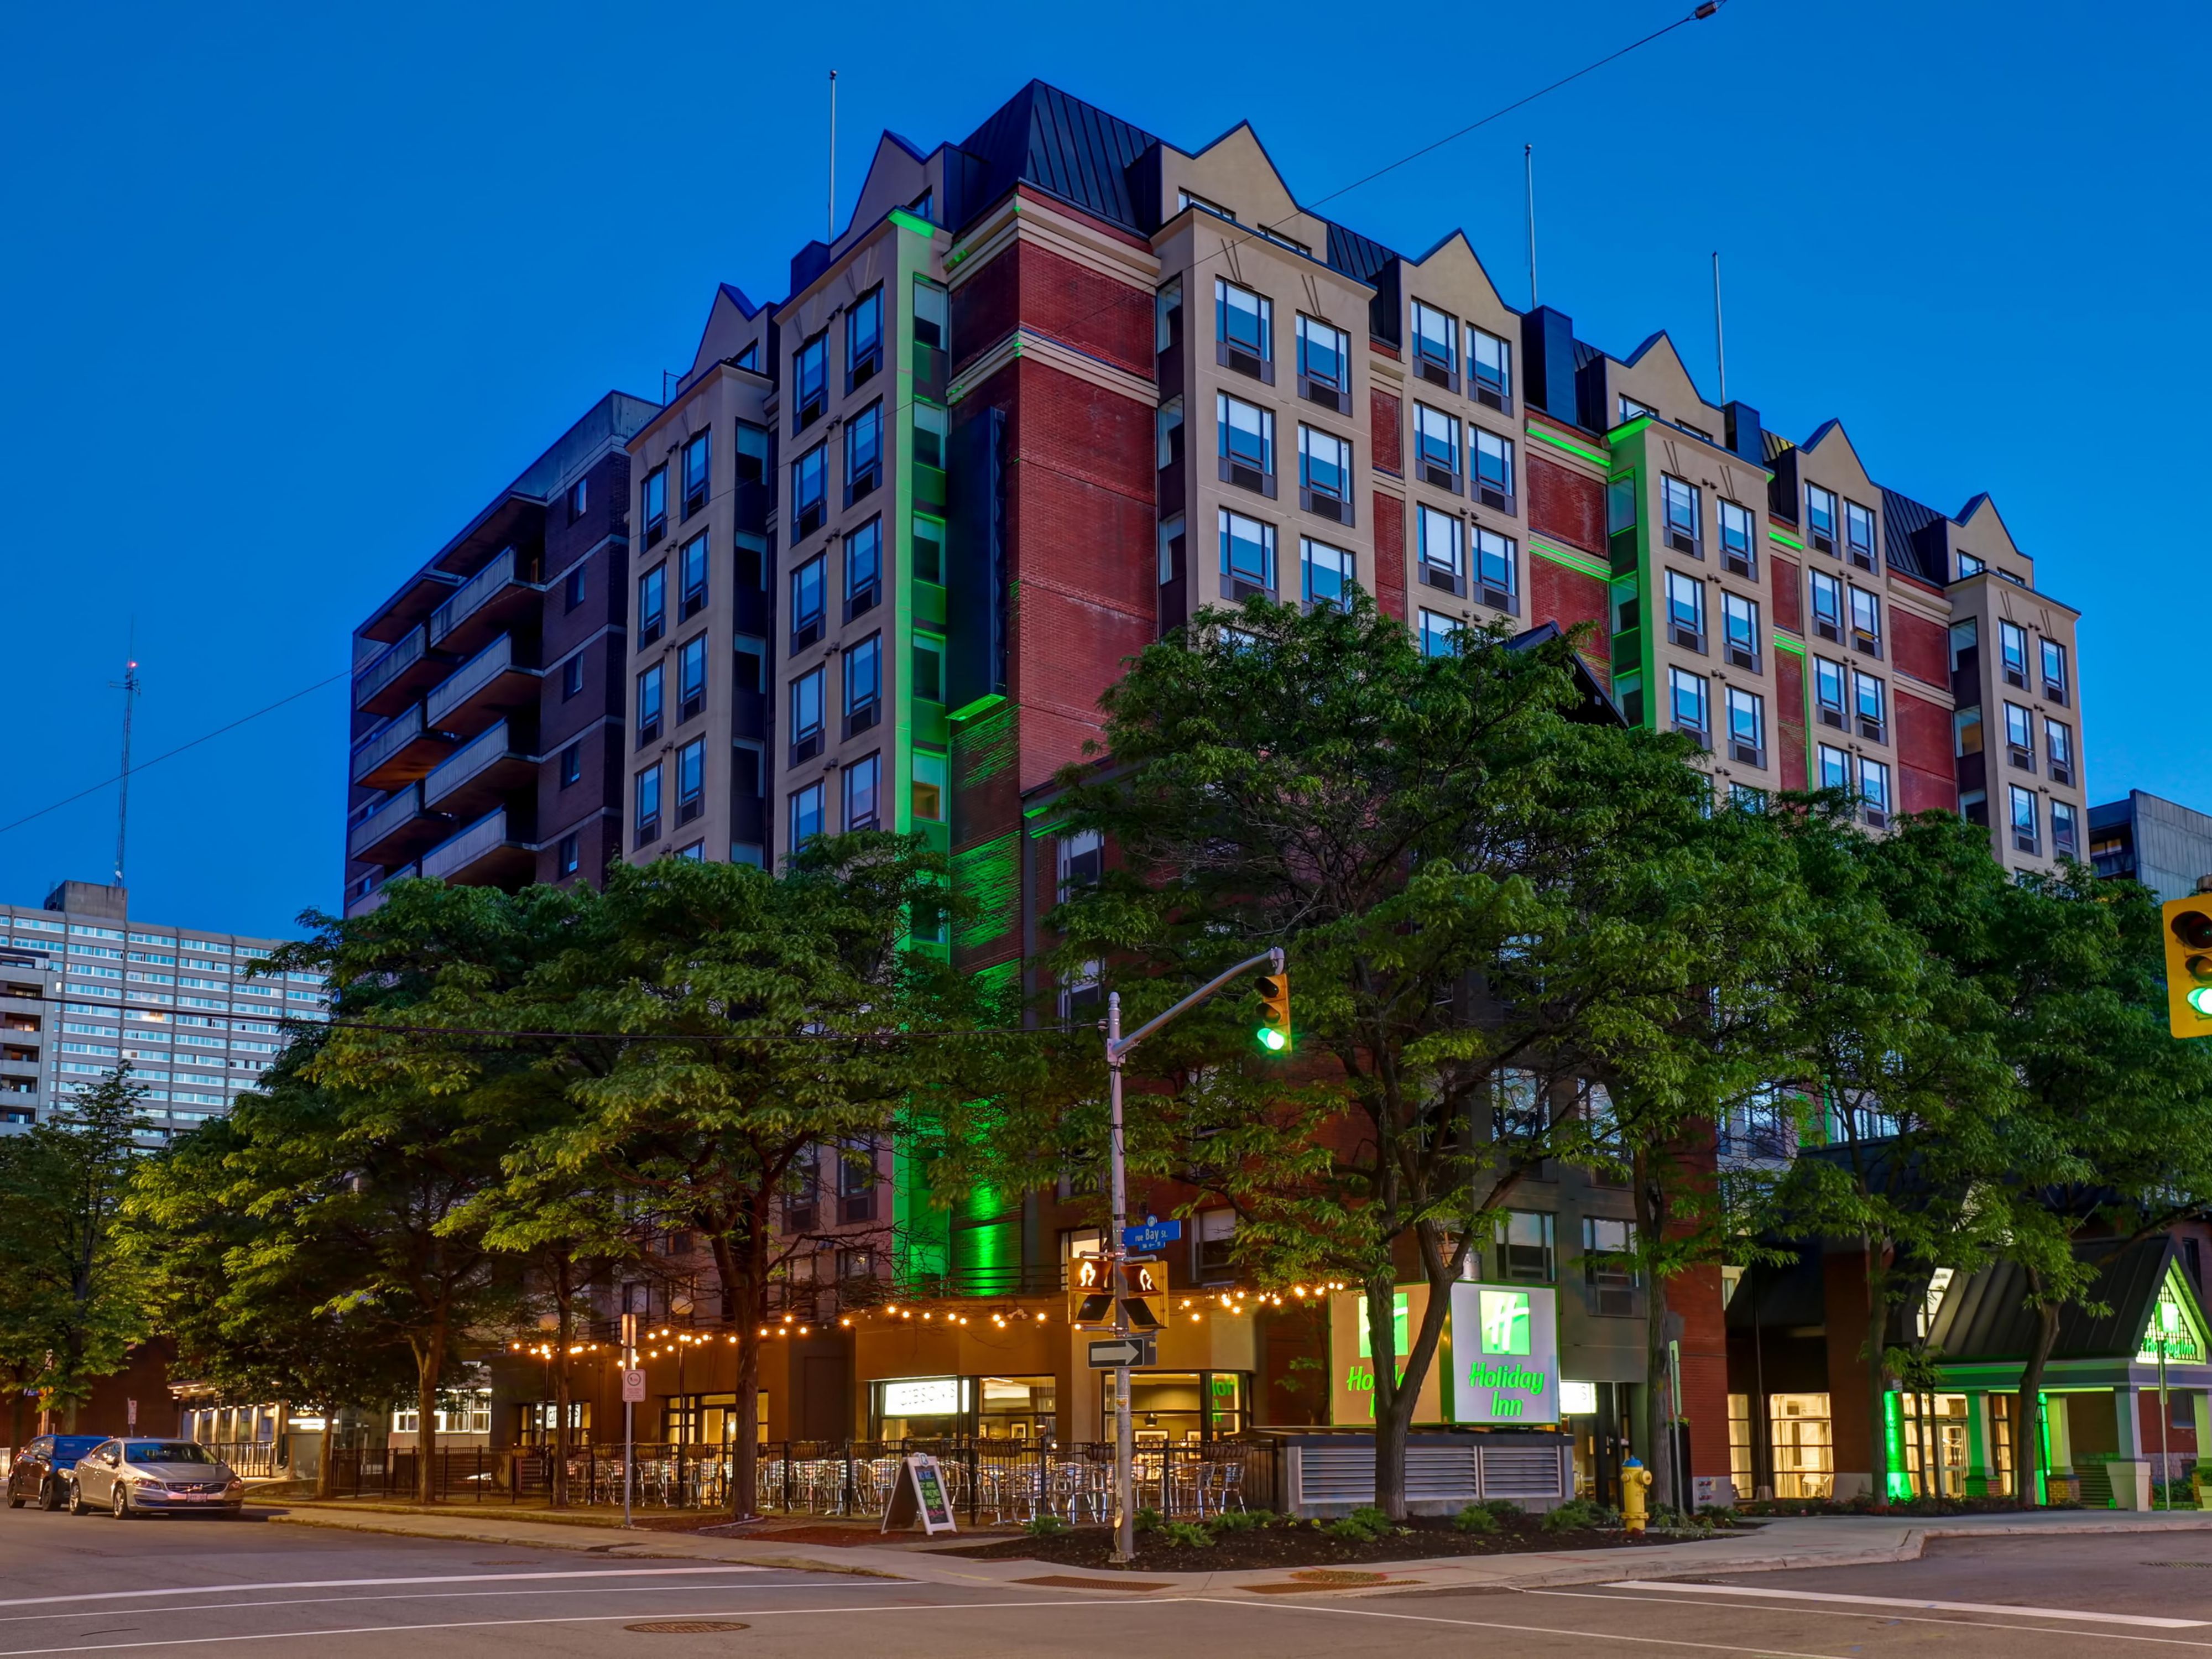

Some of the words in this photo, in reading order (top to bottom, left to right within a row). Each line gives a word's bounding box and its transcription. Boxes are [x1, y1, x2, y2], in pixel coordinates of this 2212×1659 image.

[1145, 1229, 1159, 1243] Bay
[2180, 1338, 2195, 1355] Inn
[1468, 1361, 1545, 1395] Holiday
[1491, 1390, 1523, 1417] Inn
